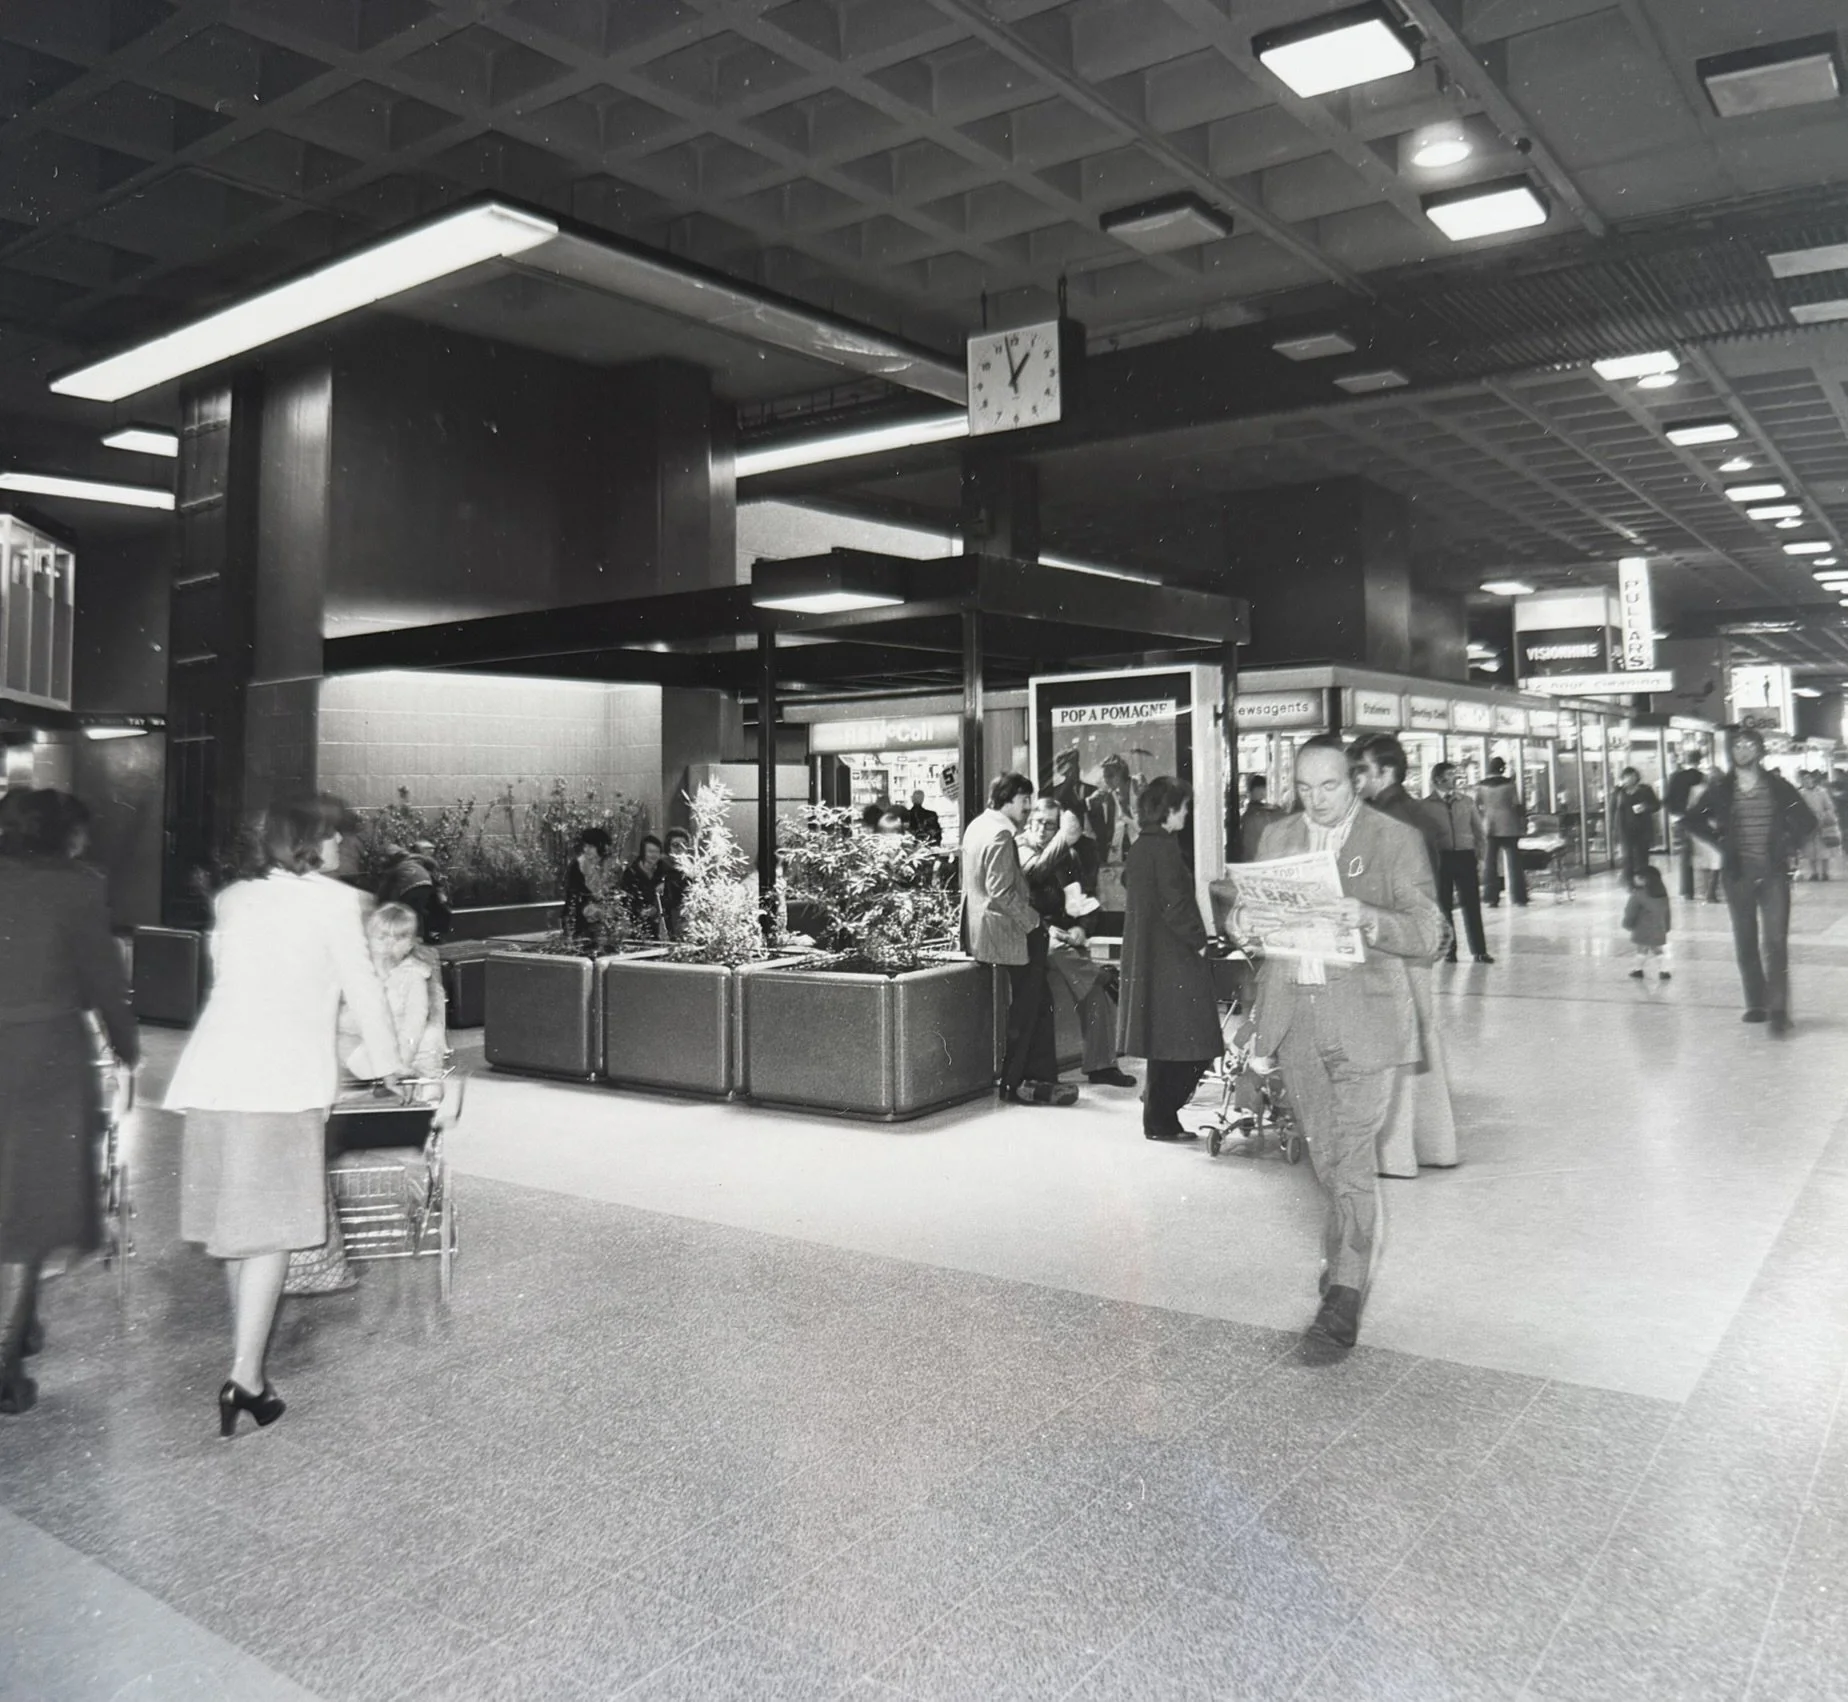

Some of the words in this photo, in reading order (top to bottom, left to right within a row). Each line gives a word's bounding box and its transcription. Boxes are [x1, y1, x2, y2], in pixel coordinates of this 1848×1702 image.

[1624, 580, 1645, 668] PULLARS
[1060, 709, 1086, 723] POP
[1088, 708, 1097, 721] A
[1238, 702, 1309, 716] ewsagents
